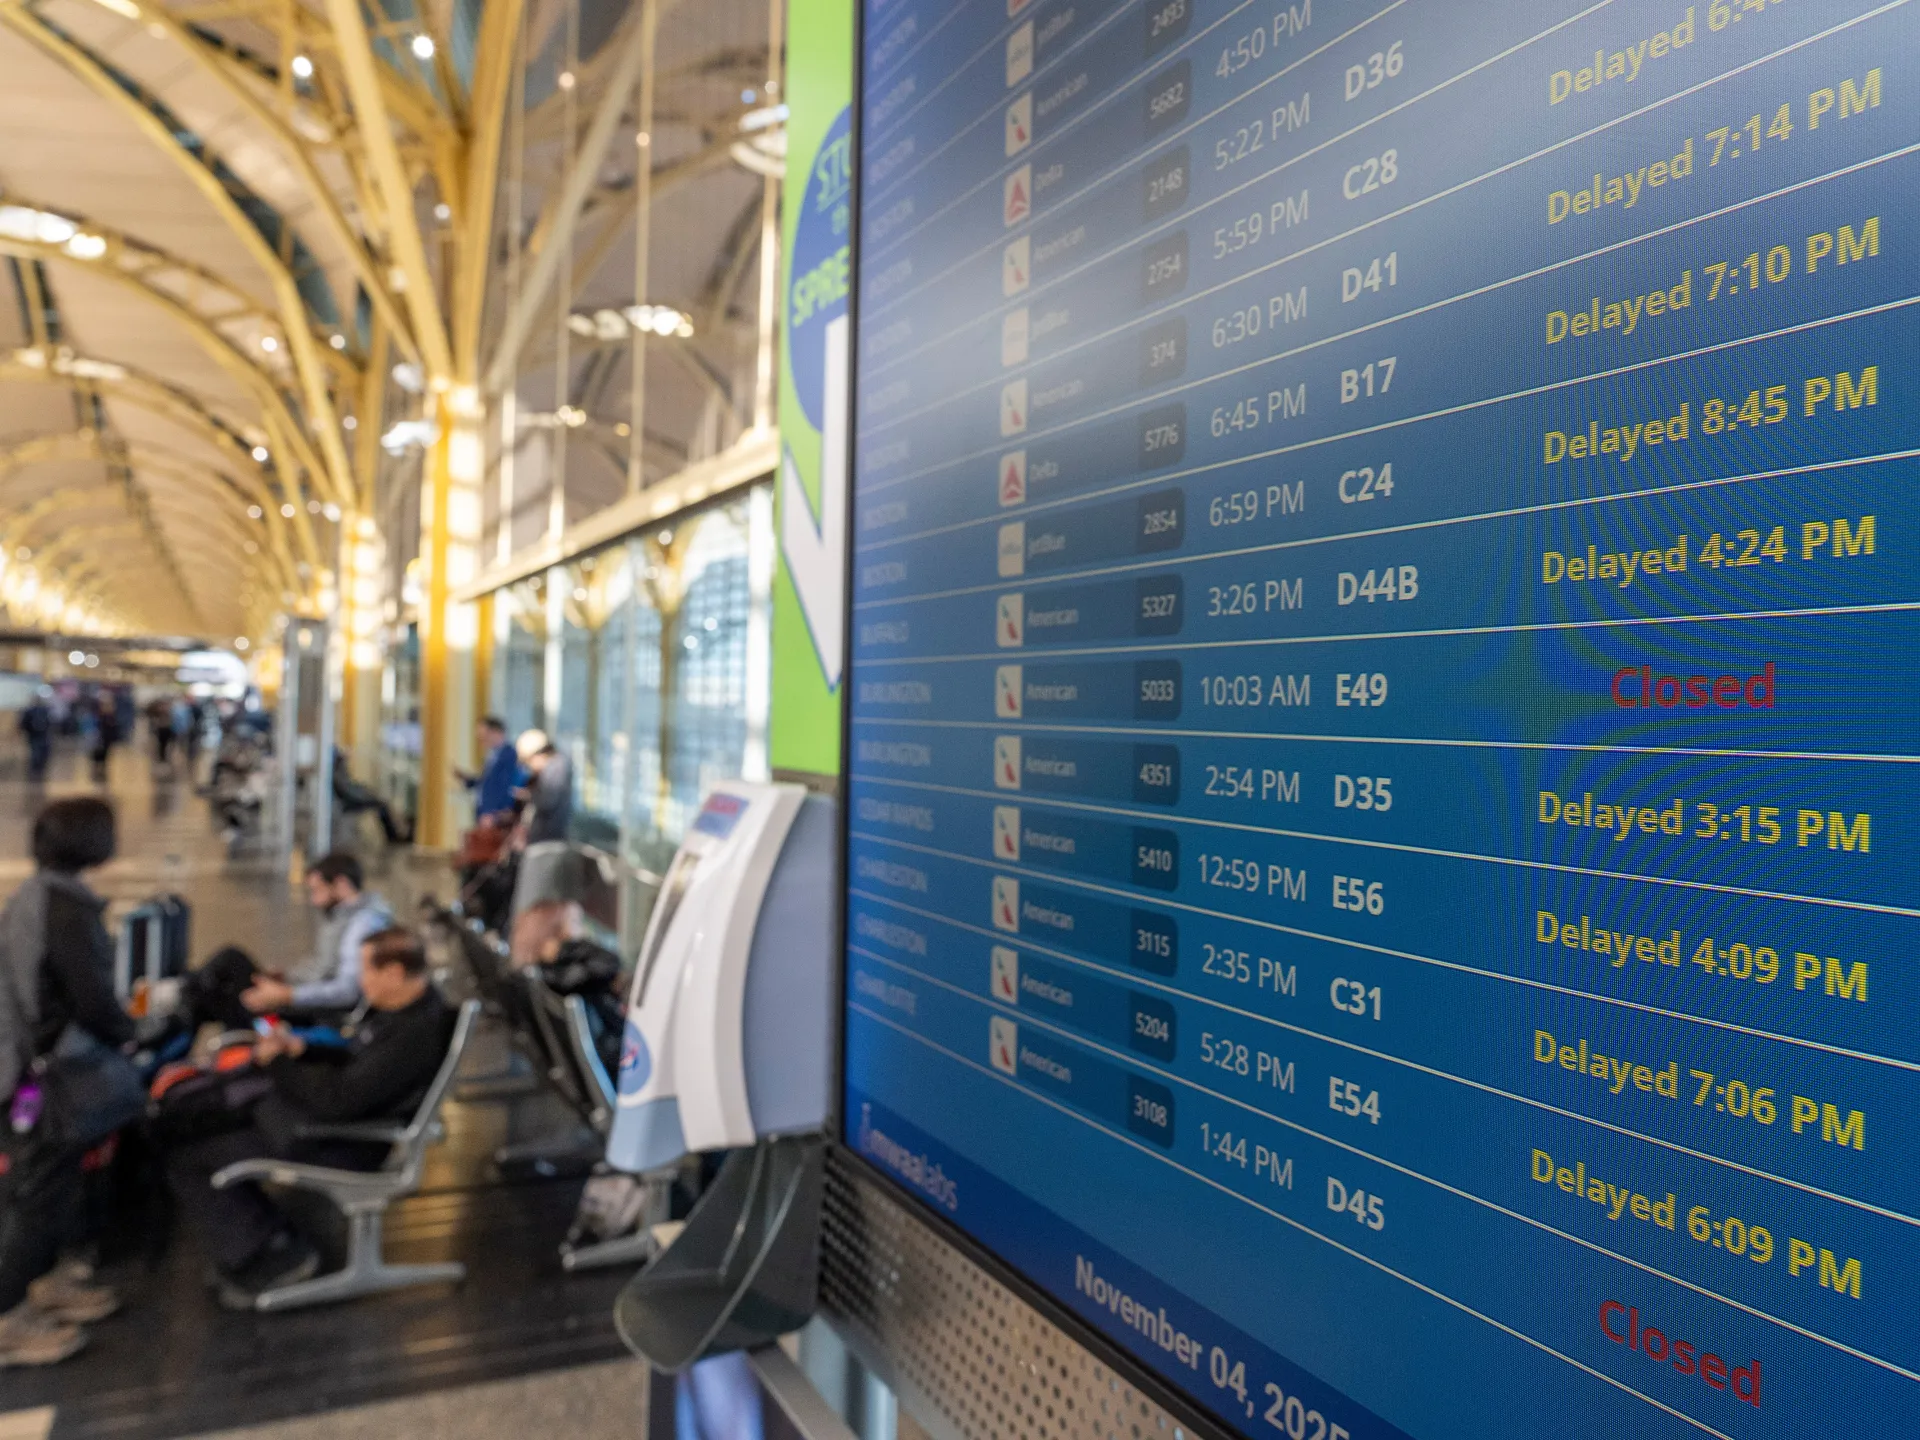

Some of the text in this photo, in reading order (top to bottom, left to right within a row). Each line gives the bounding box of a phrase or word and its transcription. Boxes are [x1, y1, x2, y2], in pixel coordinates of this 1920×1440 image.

[1149, 167, 1183, 202] 2148
[1215, 120, 1264, 171] 5:22
[1272, 91, 1310, 141] PM
[1345, 40, 1403, 102] D36
[1215, 27, 1265, 78] 4:50
[1273, 0, 1311, 47] PM
[1148, 253, 1181, 286] 2754
[1213, 212, 1262, 260] 5:59
[1271, 189, 1308, 235] PM
[1343, 148, 1398, 200] C28
[1550, 5, 1695, 106] Delayed
[1708, 0, 1784, 32] 6:
[1150, 339, 1176, 367] 374
[1212, 305, 1261, 348] 6:30
[1269, 286, 1307, 329] PM
[1342, 251, 1397, 303] D41
[1548, 137, 1693, 225] Delayed
[1705, 102, 1795, 167] 7:14
[1807, 66, 1882, 131] PM
[1144, 424, 1179, 452] 5776
[1211, 397, 1259, 438] 6:45
[1268, 383, 1305, 423] PM
[1341, 356, 1397, 404] B17
[1546, 270, 1692, 345] Delayed
[1703, 244, 1791, 301] 7:10
[1806, 216, 1881, 274] PM
[1144, 510, 1177, 535] 2854
[1210, 490, 1258, 527] 6:59
[1266, 480, 1304, 518] PM
[1339, 462, 1394, 504] C24
[1544, 402, 1690, 464] Delayed
[1702, 384, 1788, 435] 8:45
[1804, 365, 1879, 417] PM
[1027, 607, 1079, 629] American
[1142, 594, 1176, 618] 5327
[1208, 582, 1257, 617] 3:26
[1265, 577, 1303, 612] PM
[1338, 565, 1419, 606] D44B
[1542, 534, 1688, 588] Delayed
[1699, 526, 1788, 568] 4:24
[1802, 515, 1876, 561] PM
[1026, 683, 1078, 702] American
[1141, 680, 1175, 702] 5033
[1201, 675, 1262, 706] 10:03
[1269, 674, 1310, 707] AM
[1336, 672, 1388, 707] E49
[1611, 662, 1775, 708] Closed
[1025, 755, 1077, 778] American
[1139, 763, 1171, 787] 4351
[1204, 765, 1254, 799] 2:54
[1262, 769, 1299, 804] PM
[1334, 774, 1393, 812] D35
[1538, 790, 1683, 841] Delayed
[1695, 803, 1781, 845] 3:15
[1797, 809, 1870, 853] PM
[1024, 827, 1075, 854] American
[1138, 846, 1172, 873] 5410
[1198, 853, 1260, 892] 12:59
[1268, 865, 1306, 902] PM
[1333, 875, 1384, 916] E56
[1536, 910, 1681, 968] Delayed
[1692, 937, 1780, 984] 4:09
[1794, 952, 1869, 1002] PM
[1023, 900, 1074, 931] American
[1136, 928, 1171, 957] 3115
[1202, 944, 1250, 984] 2:35
[1259, 958, 1296, 997] PM
[1330, 977, 1381, 1021] C31
[1534, 1029, 1678, 1099] Delayed
[1690, 1068, 1777, 1125] 7:06
[1791, 1094, 1865, 1152] PM
[1021, 972, 1073, 1008] American
[1135, 1011, 1169, 1043] 5204
[1201, 1032, 1249, 1077] 5:28
[1257, 1052, 1295, 1094] PM
[1329, 1076, 1381, 1125] E54
[1531, 1148, 1676, 1231] Delayed
[1688, 1205, 1774, 1264] 6:09
[1788, 1237, 1863, 1299] PM
[1021, 1045, 1072, 1084] American
[1134, 1095, 1167, 1129] 3108
[1200, 1122, 1247, 1169] 1:44
[1255, 1145, 1293, 1191] PM
[1327, 1176, 1385, 1231] D45
[1599, 1299, 1762, 1409] Closed
[1075, 1254, 1202, 1370] November
[1210, 1346, 1254, 1419] 04,
